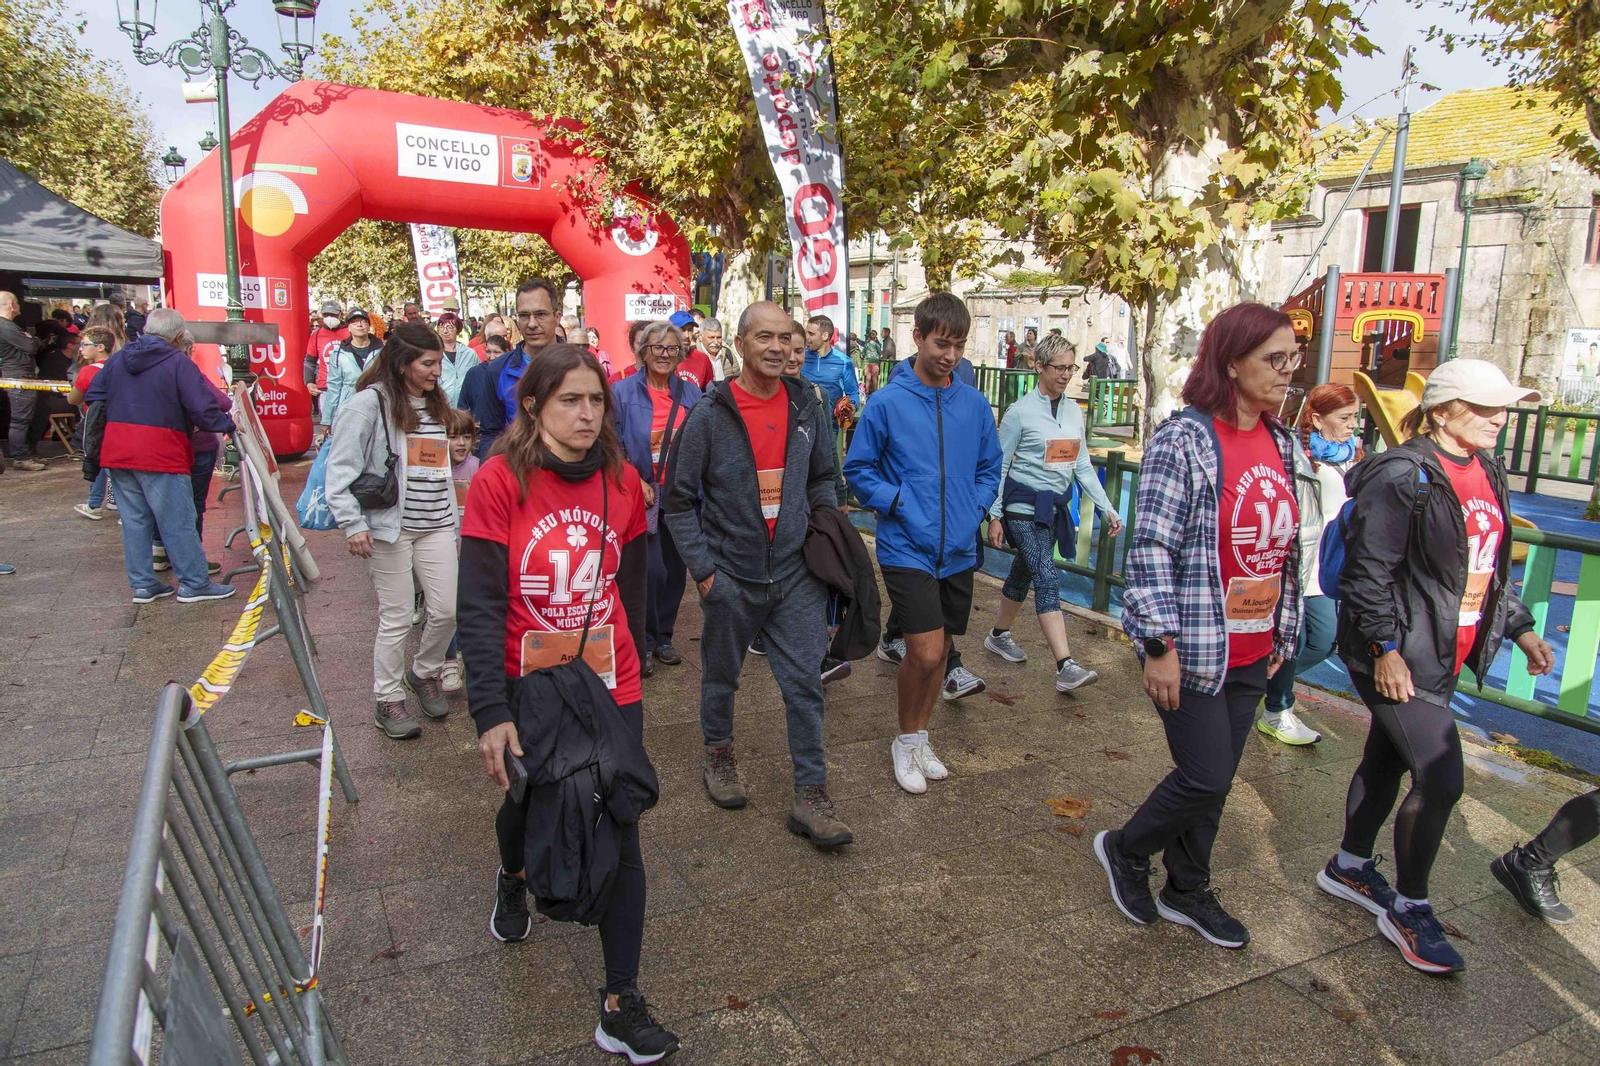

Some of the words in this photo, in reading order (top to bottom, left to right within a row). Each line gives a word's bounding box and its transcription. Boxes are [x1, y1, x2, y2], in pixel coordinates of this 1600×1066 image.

[771, 0, 813, 11] CONCELLO
[778, 11, 787, 20] DE
[790, 10, 809, 19] VIGO
[762, 53, 802, 165] deporte
[405, 134, 490, 156] CONCELLO
[416, 152, 437, 168] DE
[444, 155, 481, 172] VIGO
[209, 291, 223, 299] DE
[629, 299, 672, 307] CONCELLO
[760, 486, 780, 495] ntonio
[1235, 470, 1254, 496] #EU
[531, 513, 559, 541] #EU
[1254, 500, 1296, 552] 14
[1467, 531, 1500, 572] 14
[548, 549, 606, 605] 14
[541, 607, 565, 618] POLA
